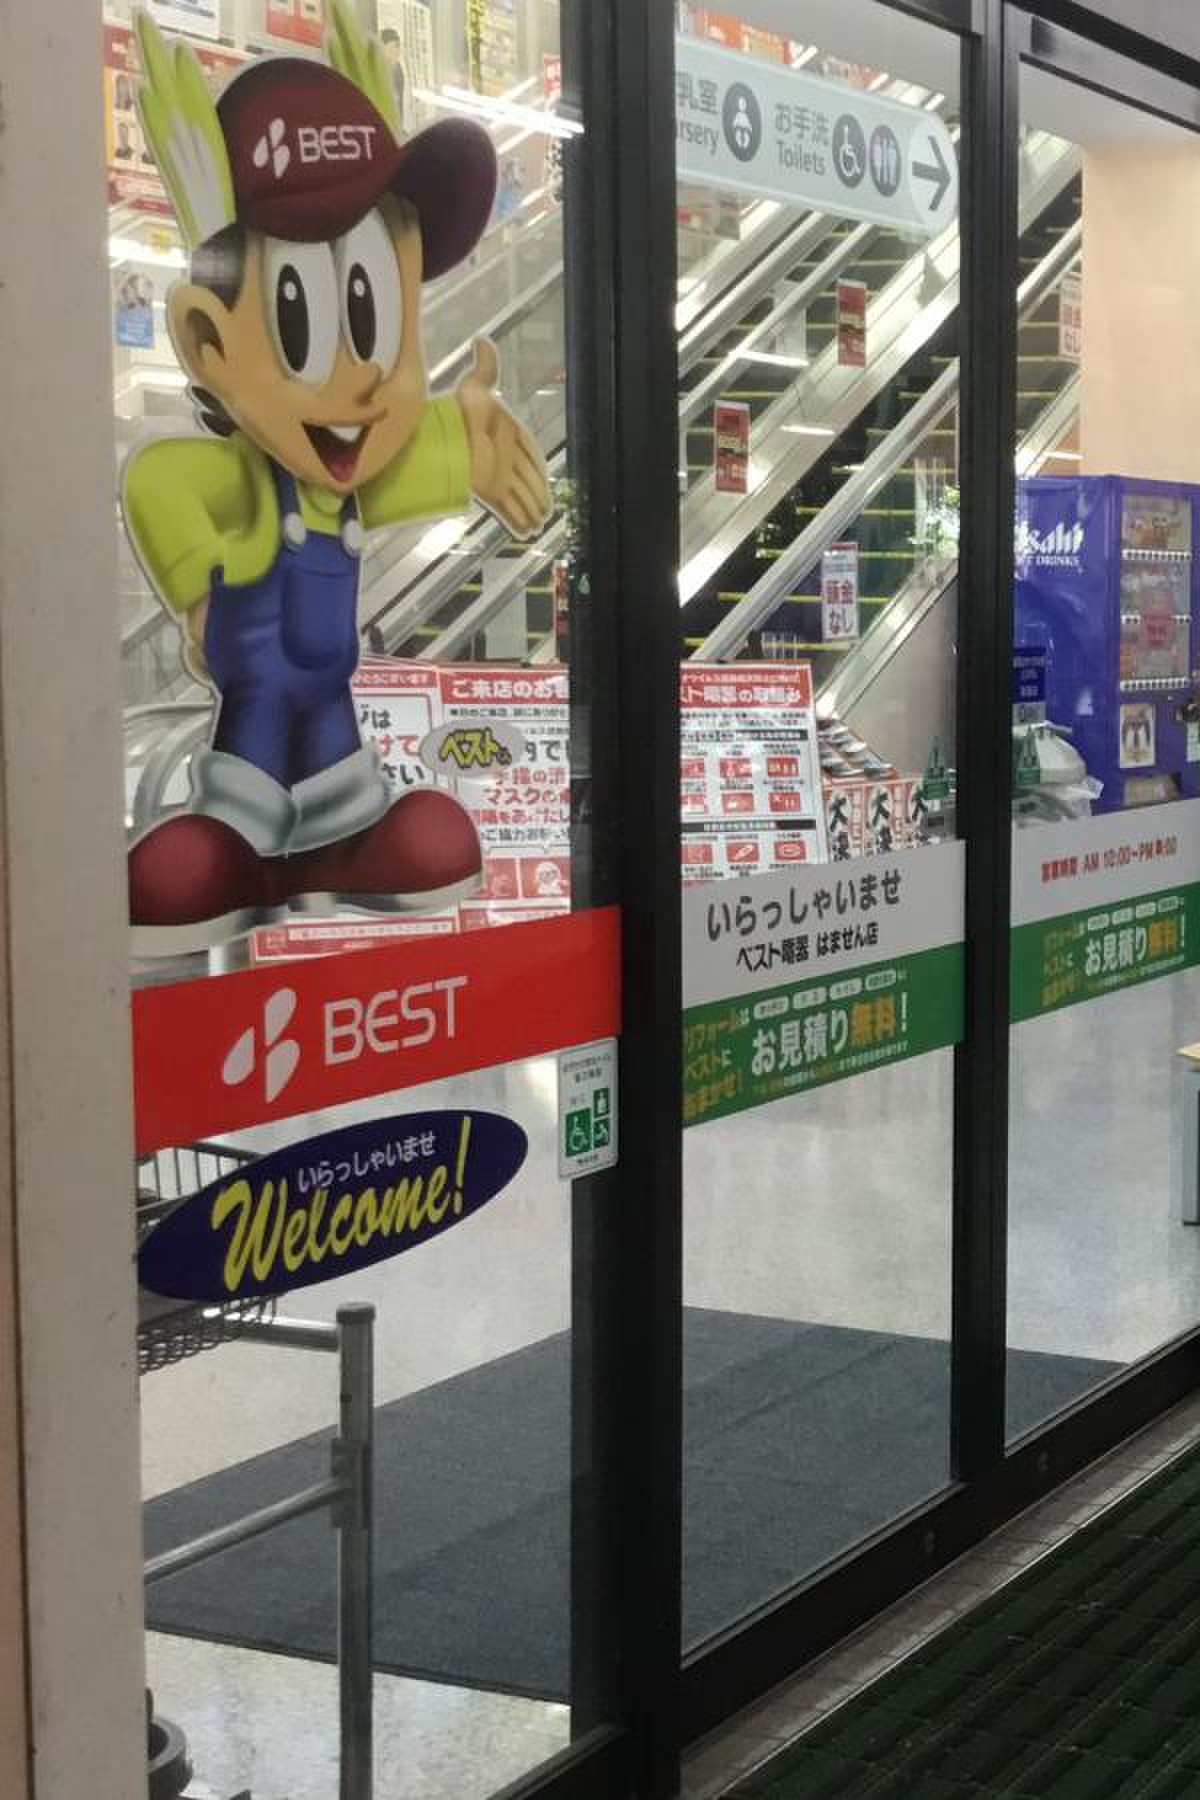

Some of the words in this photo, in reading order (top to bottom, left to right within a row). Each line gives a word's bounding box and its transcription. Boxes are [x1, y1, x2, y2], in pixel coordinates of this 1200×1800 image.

[298, 125, 377, 163] BEST
[775, 104, 829, 147] お手洗
[777, 140, 827, 176] Toilets
[1083, 852, 1100, 873] AM
[706, 868, 902, 942] いらっしゃいませ
[736, 935, 810, 973] ベスト電器
[816, 921, 879, 957] はません店
[324, 975, 468, 1066] BEST
[298, 1130, 437, 1193] いらっしゃいませ
[212, 1115, 472, 1291] Welcome!
